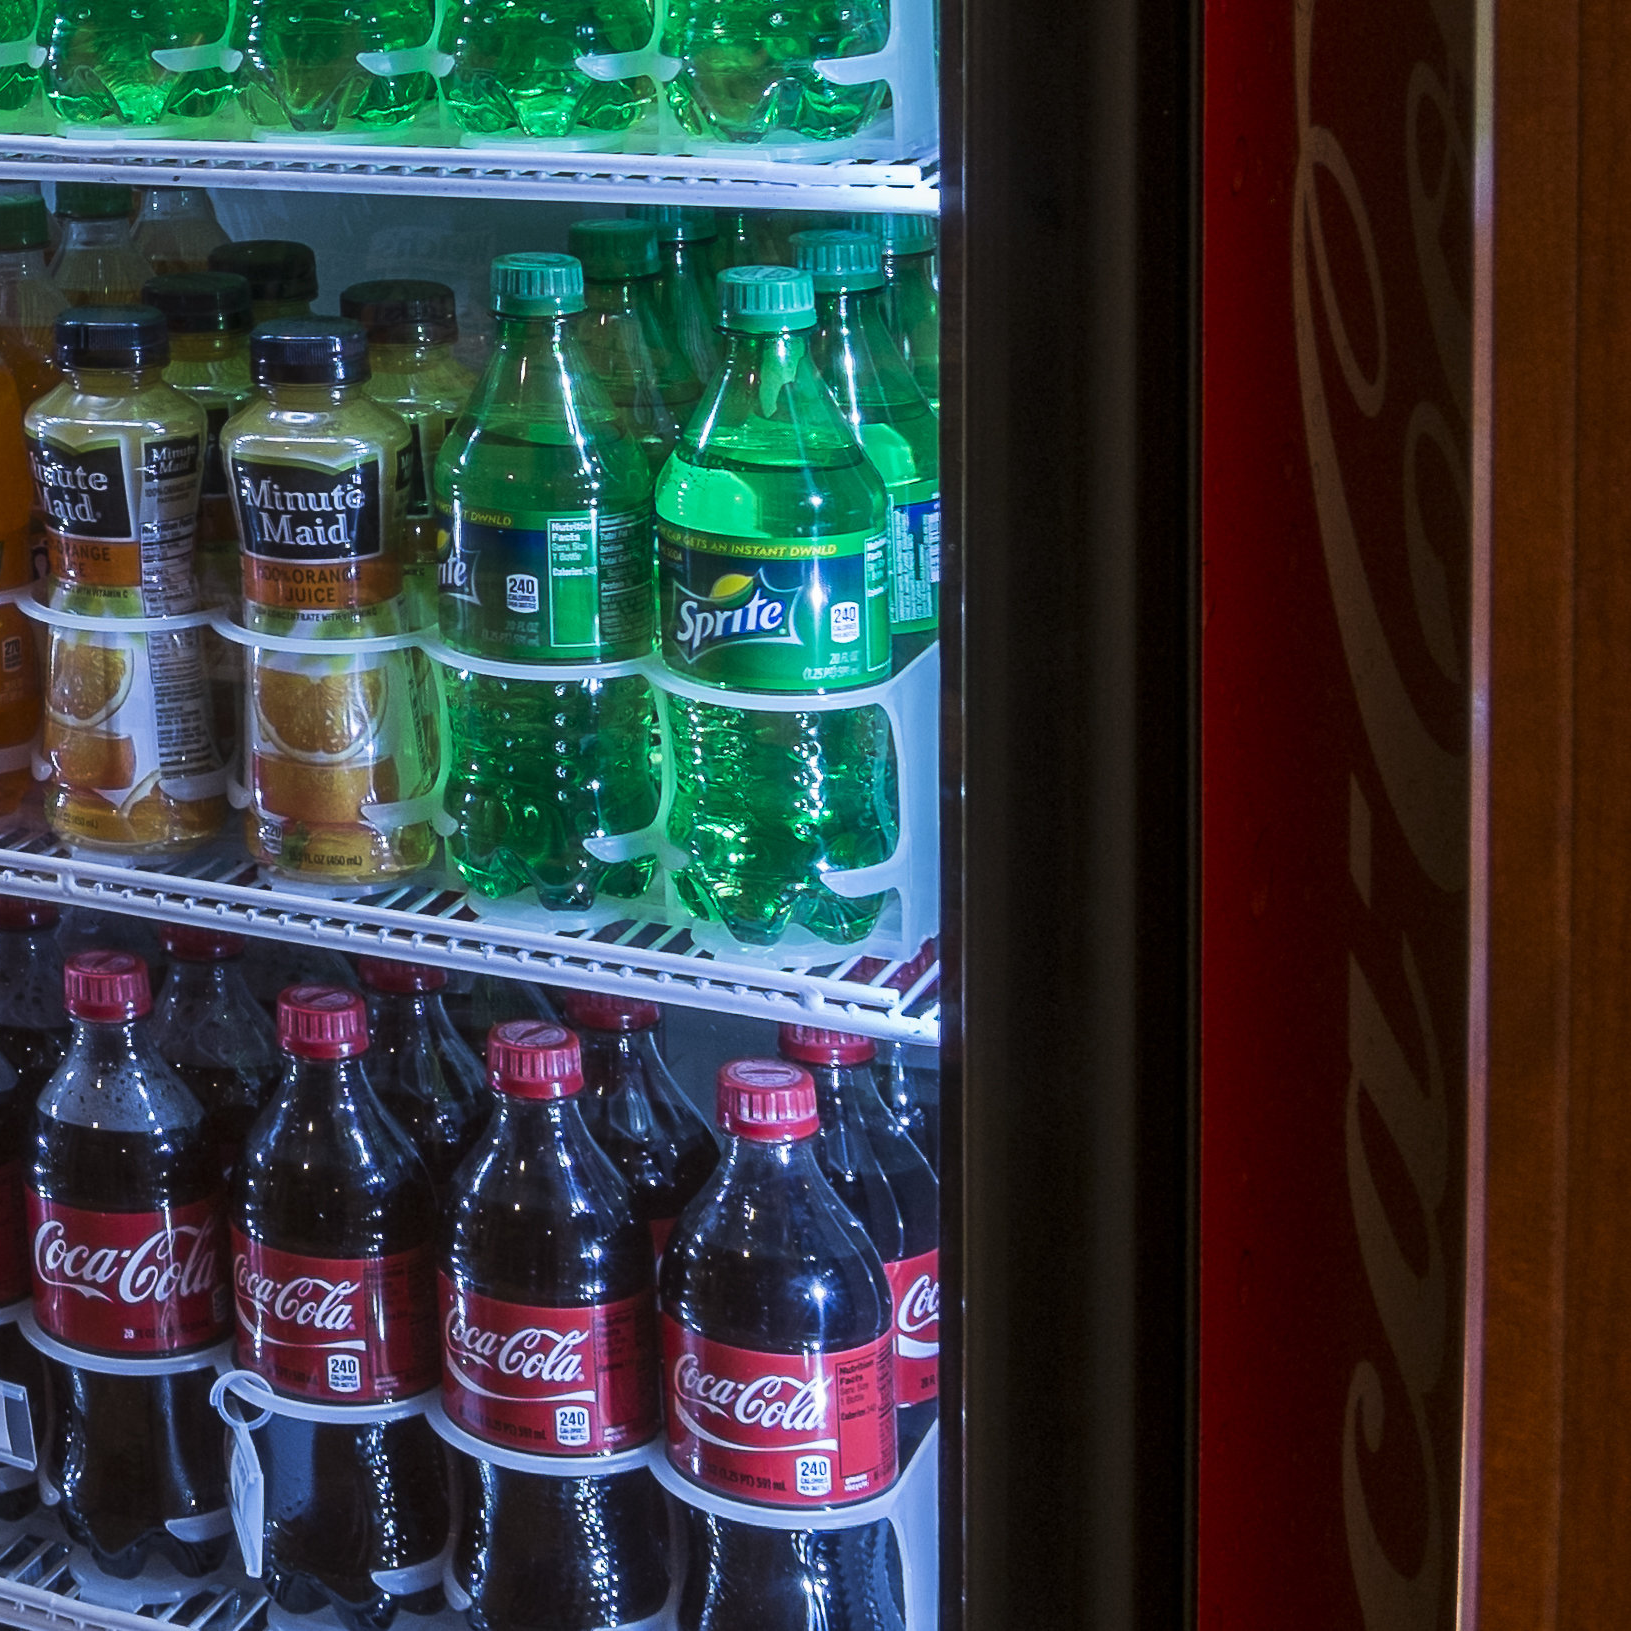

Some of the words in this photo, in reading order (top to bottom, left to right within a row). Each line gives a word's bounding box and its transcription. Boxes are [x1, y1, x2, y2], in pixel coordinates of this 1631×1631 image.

[152, 445, 197, 462] Minute
[159, 460, 191, 474] Maid
[245, 477, 366, 511] Minute
[471, 512, 512, 526] DWNLD
[259, 512, 351, 546] Maid
[552, 533, 581, 541] Facts
[56, 541, 112, 562] ORANGE
[684, 535, 707, 549] GETS
[711, 544, 728, 552] AN
[731, 545, 787, 557] INSTANT
[790, 544, 837, 557] DWNLD
[558, 552, 582, 561] Bottle
[292, 565, 362, 585] ORANGE
[92, 588, 120, 599] VITAMIN
[121, 590, 128, 599] C
[508, 578, 536, 594] 240
[284, 587, 336, 603] JUICE
[677, 588, 783, 651] Sprite
[833, 606, 856, 623] 240
[4, 641, 20, 655] 270
[34, 1218, 216, 1304] Coca-Cola
[234, 1253, 361, 1331] Coca-Cola
[123, 1328, 135, 1339] 20
[445, 1306, 590, 1382] Coca-Cola
[331, 1359, 357, 1374] 240
[839, 1360, 874, 1375] Nutrition
[839, 1375, 864, 1385] Facts
[674, 1353, 833, 1430] Coca-Cola
[559, 1411, 585, 1426] 240
[840, 1409, 865, 1420] Calories
[801, 1461, 827, 1476] 240
[739, 1472, 755, 1487] PT)
[756, 1476, 772, 1490] 591
[773, 1480, 787, 1492] mL
[800, 1477, 829, 1485] CALORIES
